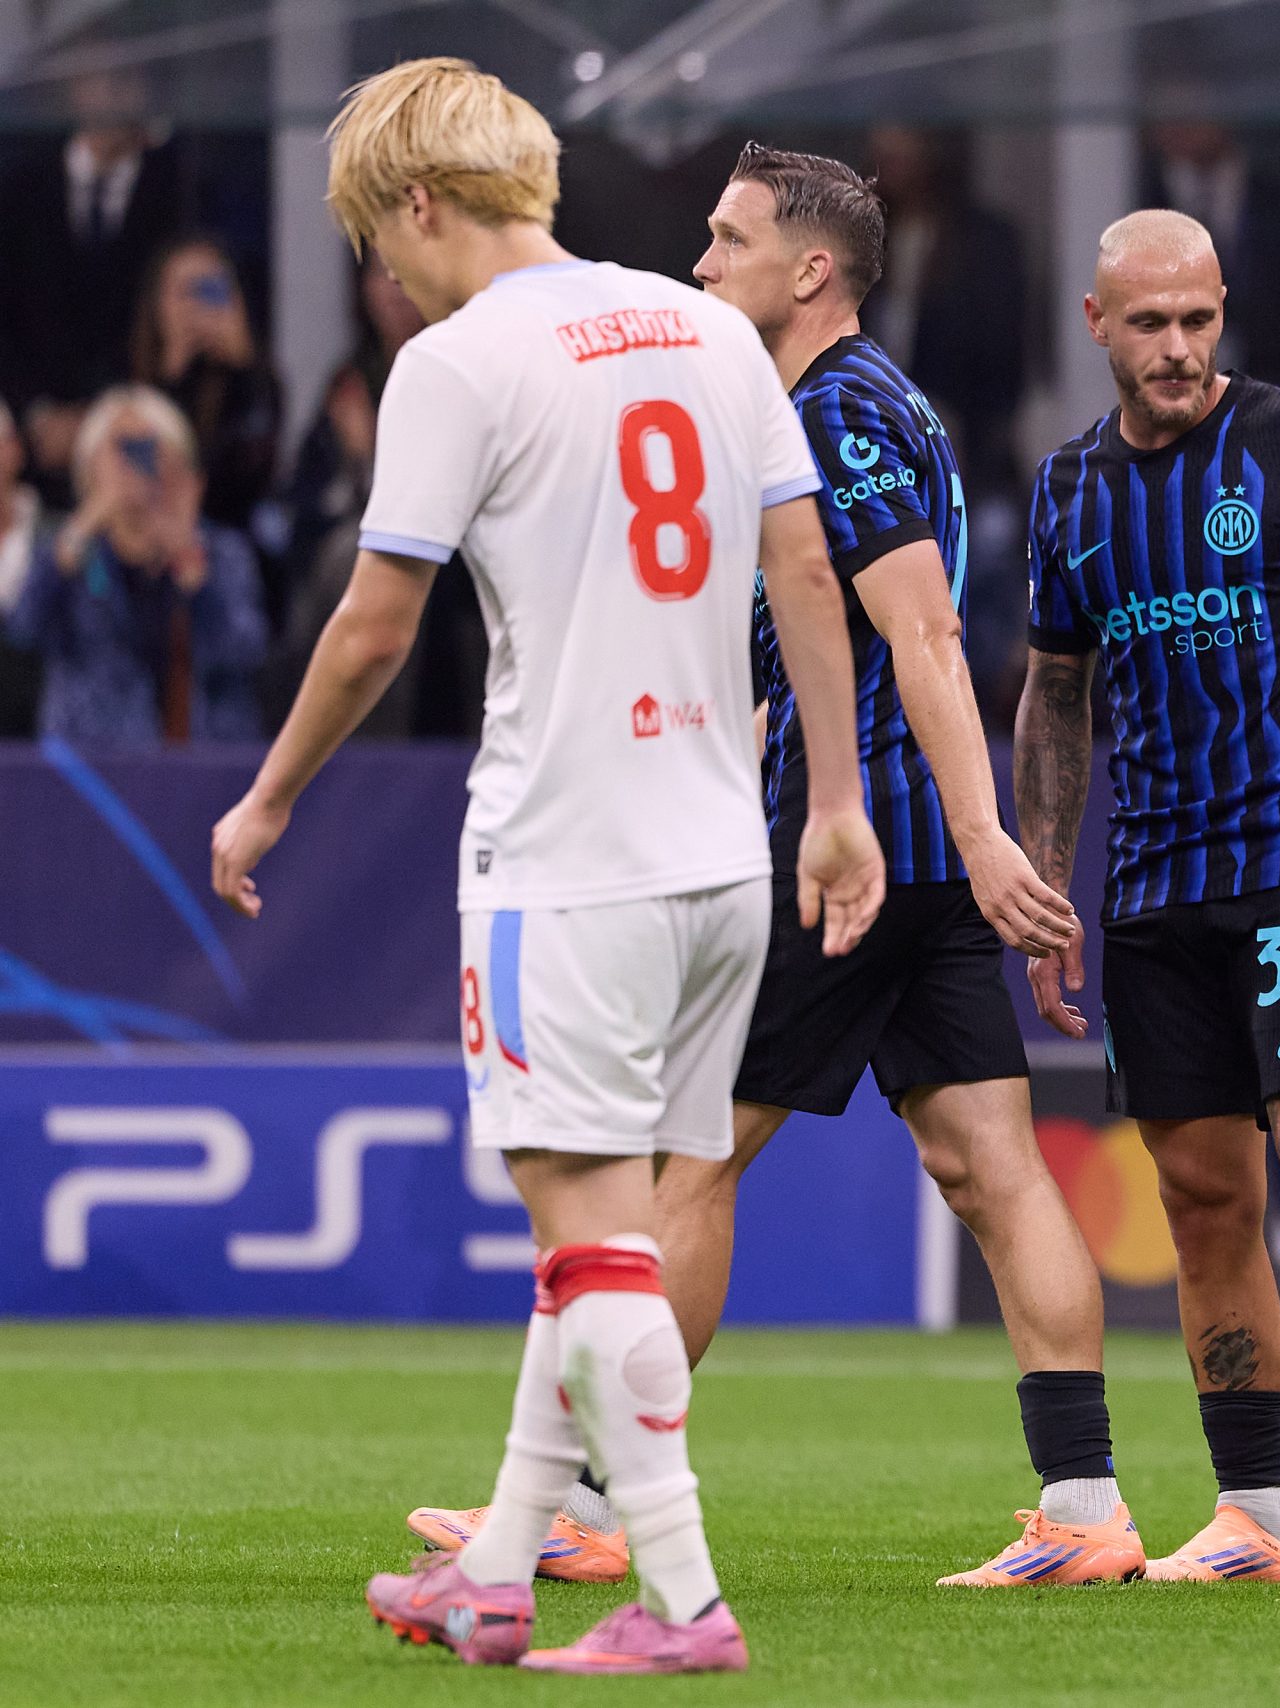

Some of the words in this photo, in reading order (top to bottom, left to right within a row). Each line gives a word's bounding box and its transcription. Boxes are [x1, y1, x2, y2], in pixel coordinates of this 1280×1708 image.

[618, 400, 713, 602] 8
[832, 467, 916, 510] Gate.io
[463, 967, 485, 1055] 8
